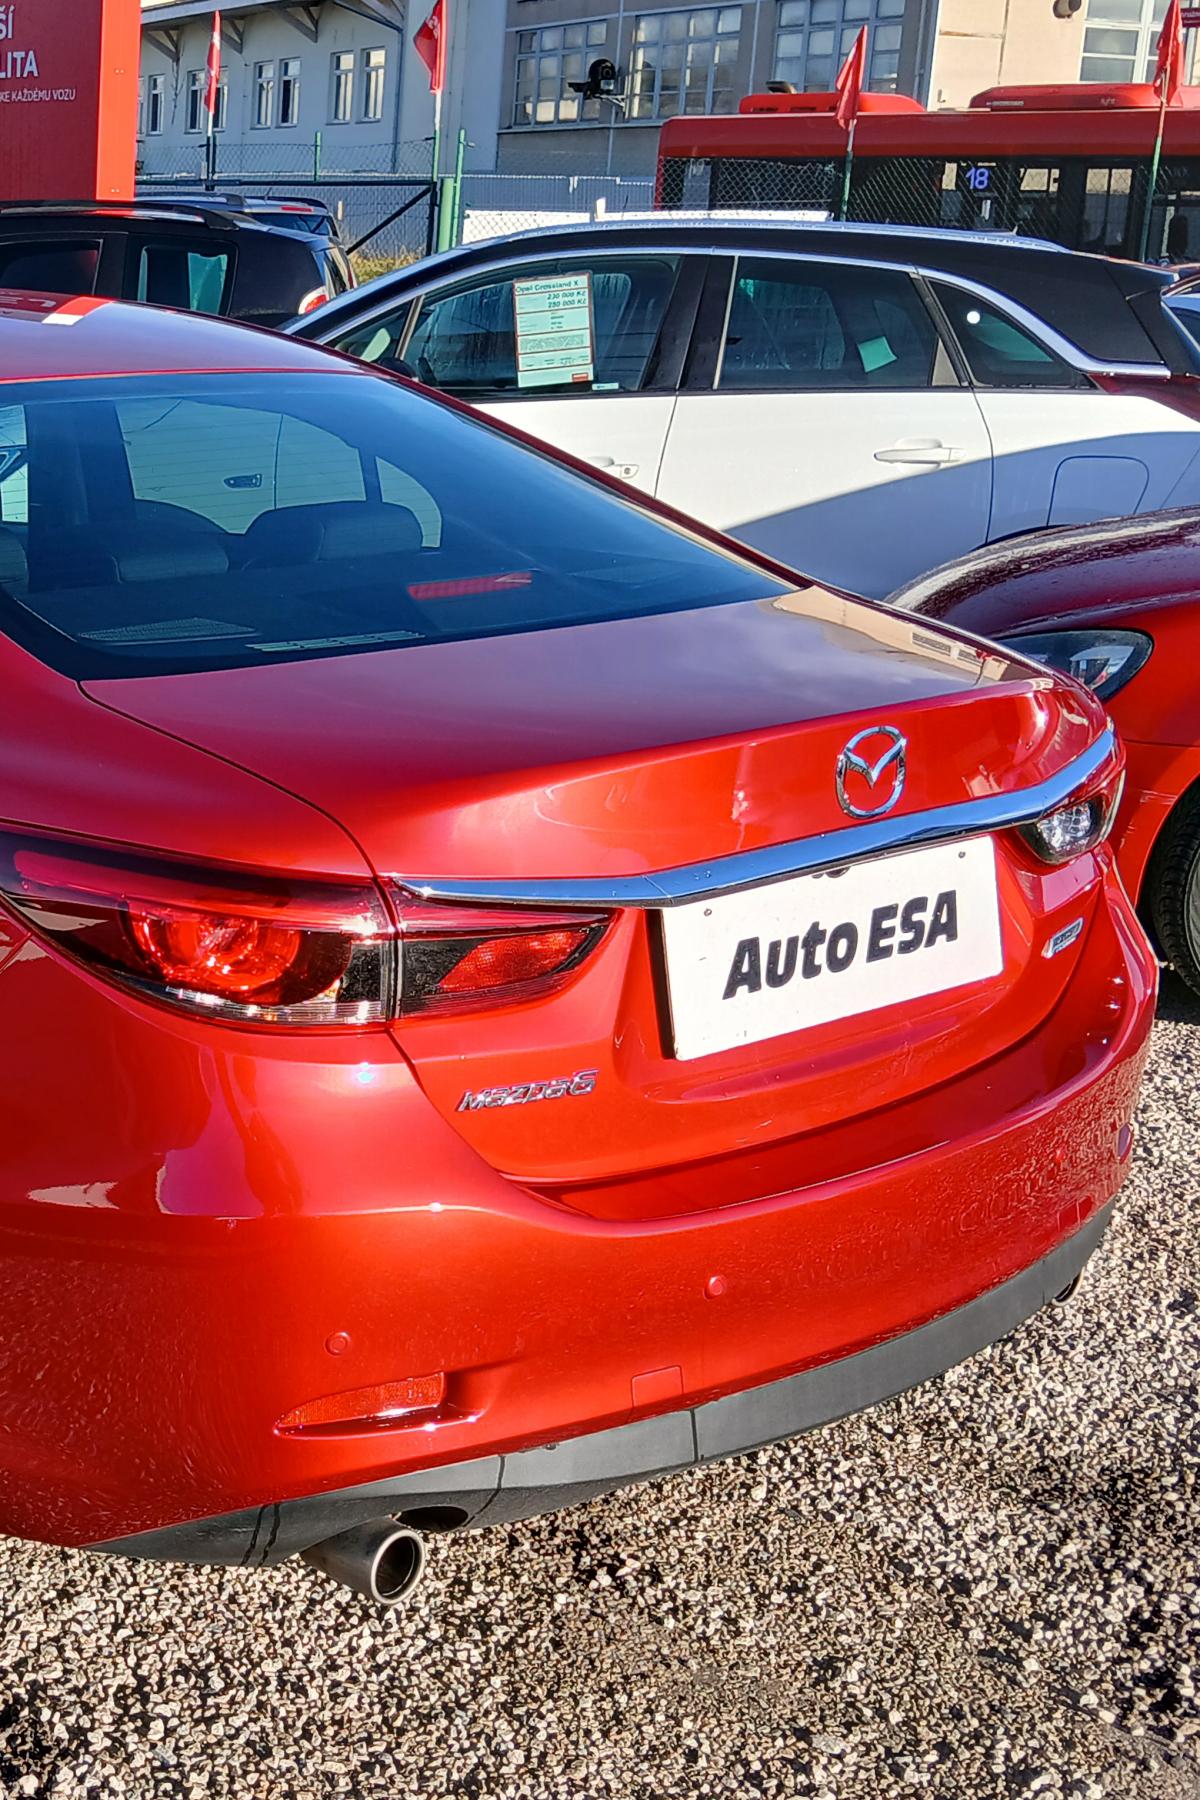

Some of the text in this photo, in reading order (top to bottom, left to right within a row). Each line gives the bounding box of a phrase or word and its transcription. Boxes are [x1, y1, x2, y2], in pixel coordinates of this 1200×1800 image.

[0, 90, 11, 103] KE
[52, 88, 76, 101] VOZU
[965, 166, 989, 190] 18
[722, 921, 859, 1000] Auto
[866, 890, 958, 964] ESA
